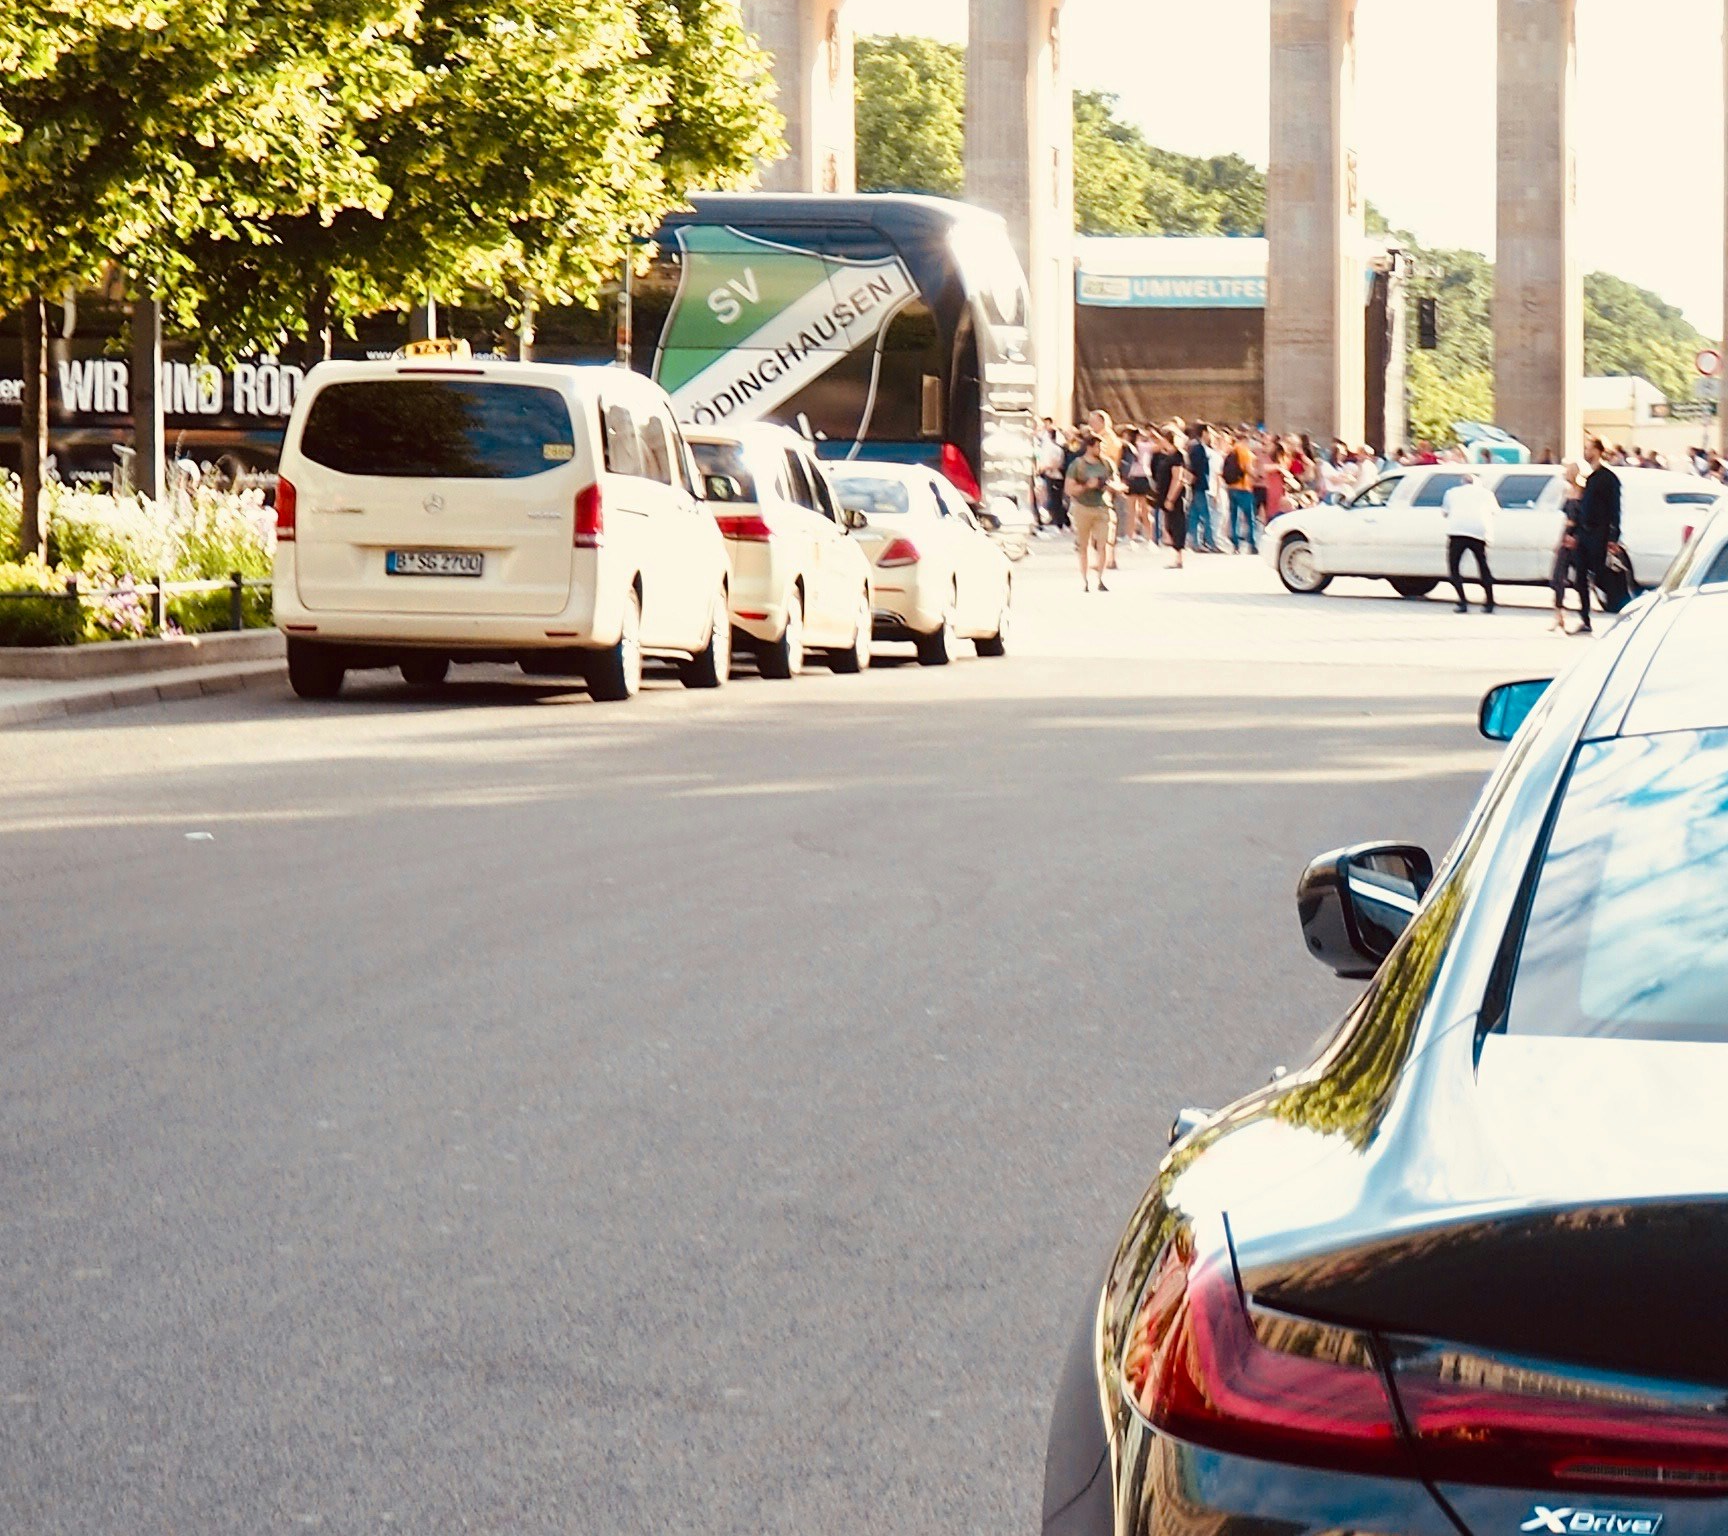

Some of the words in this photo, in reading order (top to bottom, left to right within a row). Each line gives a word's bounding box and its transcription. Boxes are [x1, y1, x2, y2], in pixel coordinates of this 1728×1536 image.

[707, 267, 760, 324] SV
[1133, 278, 1267, 298] UMWELTFES
[680, 275, 893, 425] ÖDINGHAUSEN
[58, 359, 130, 413] WIR
[162, 360, 223, 415] IND
[233, 353, 303, 415] RÖD
